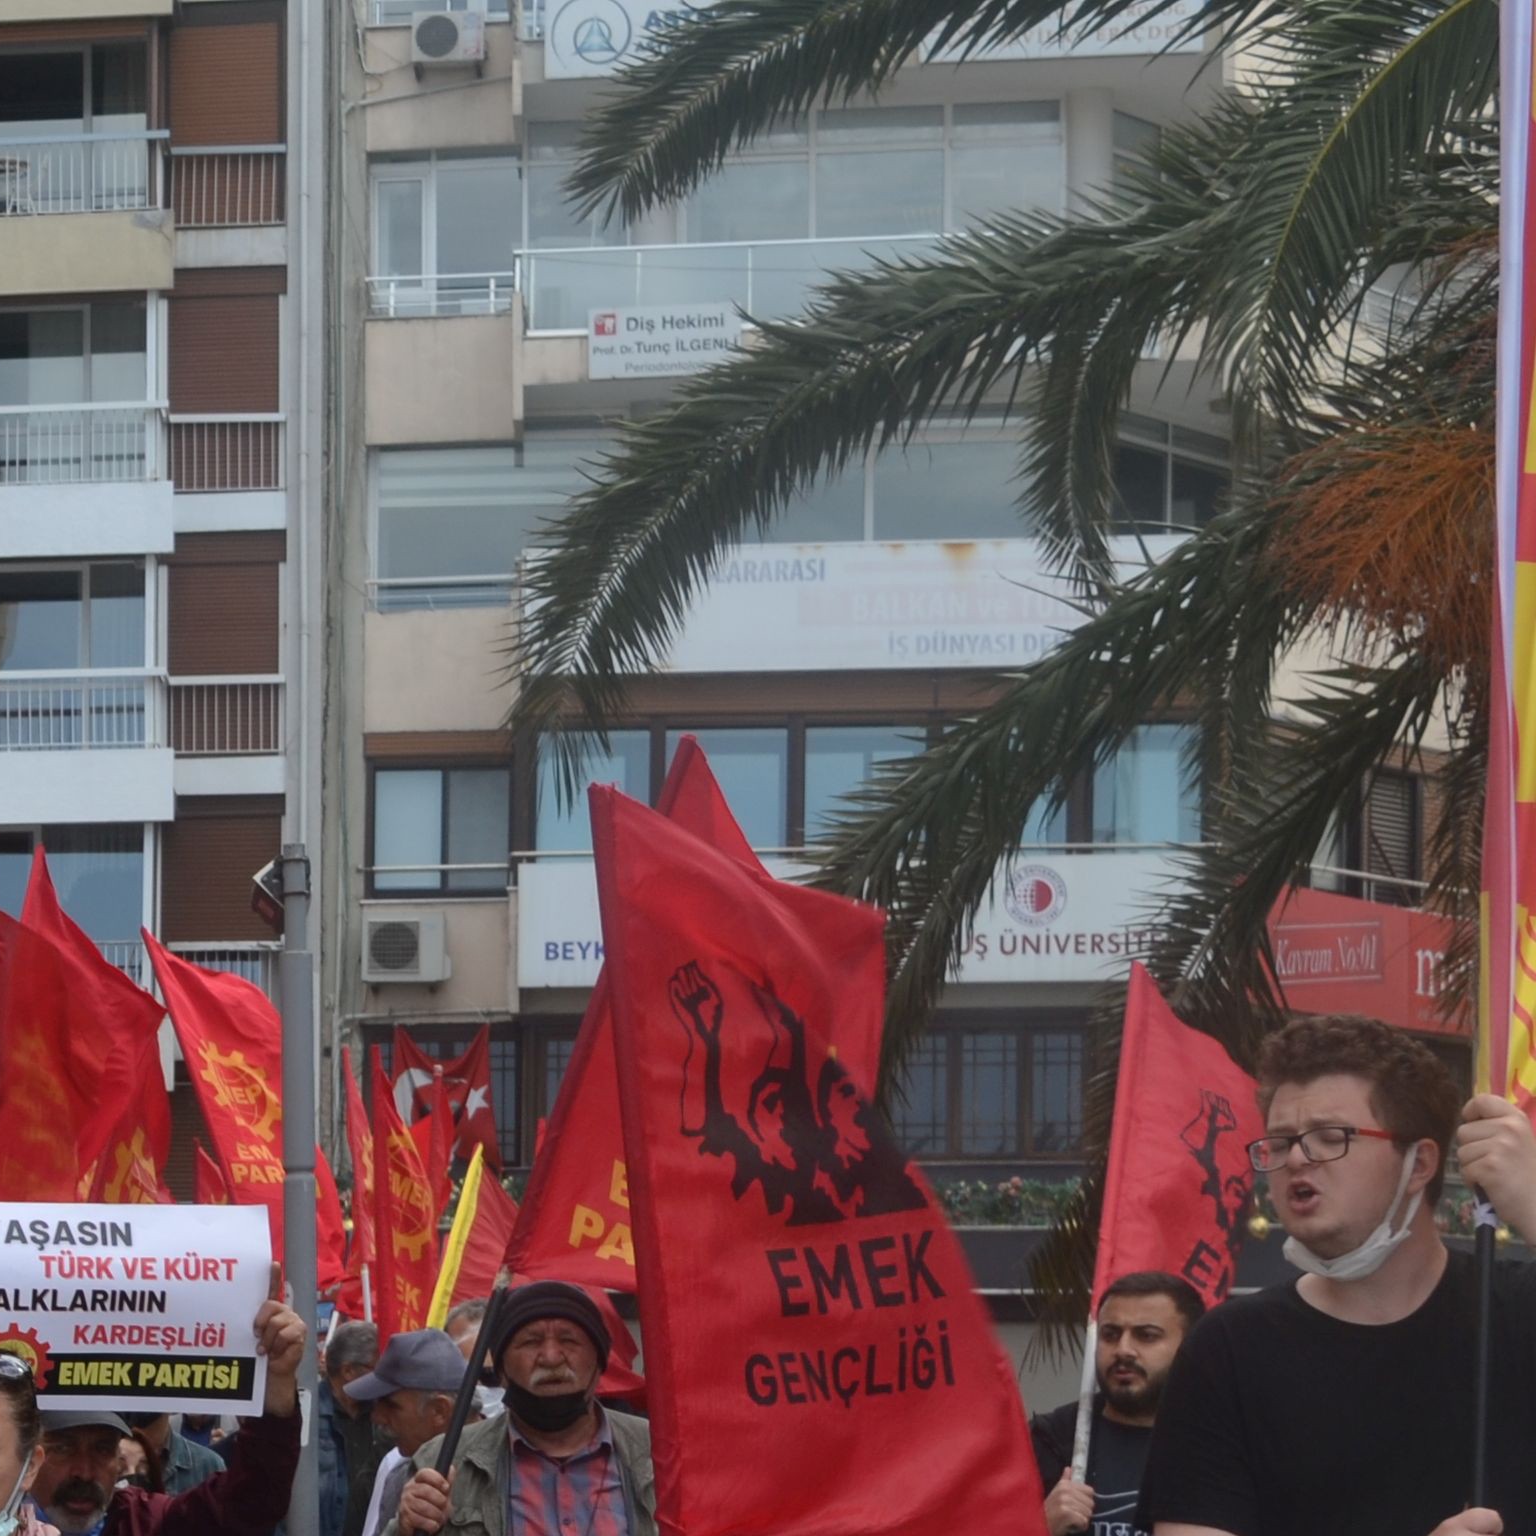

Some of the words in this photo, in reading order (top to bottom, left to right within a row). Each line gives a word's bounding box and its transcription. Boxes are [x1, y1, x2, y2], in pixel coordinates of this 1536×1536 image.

[625, 316, 656, 335] Diş
[661, 312, 725, 331] Hekimi
[632, 340, 671, 355] Tunç
[914, 629, 1016, 657] DÜNYASI
[1275, 938, 1333, 977] Kavram
[38, 1249, 114, 1281] TÜRK
[120, 1256, 157, 1281] VE
[163, 1251, 239, 1282] KÜRT
[767, 1230, 947, 1321] EMEK
[72, 1322, 227, 1352] KARDEŞLİĞİ
[58, 1361, 133, 1387] EMEK
[137, 1358, 240, 1391] PARTİSİ
[743, 1319, 957, 1409] GENÇLİĞİ
